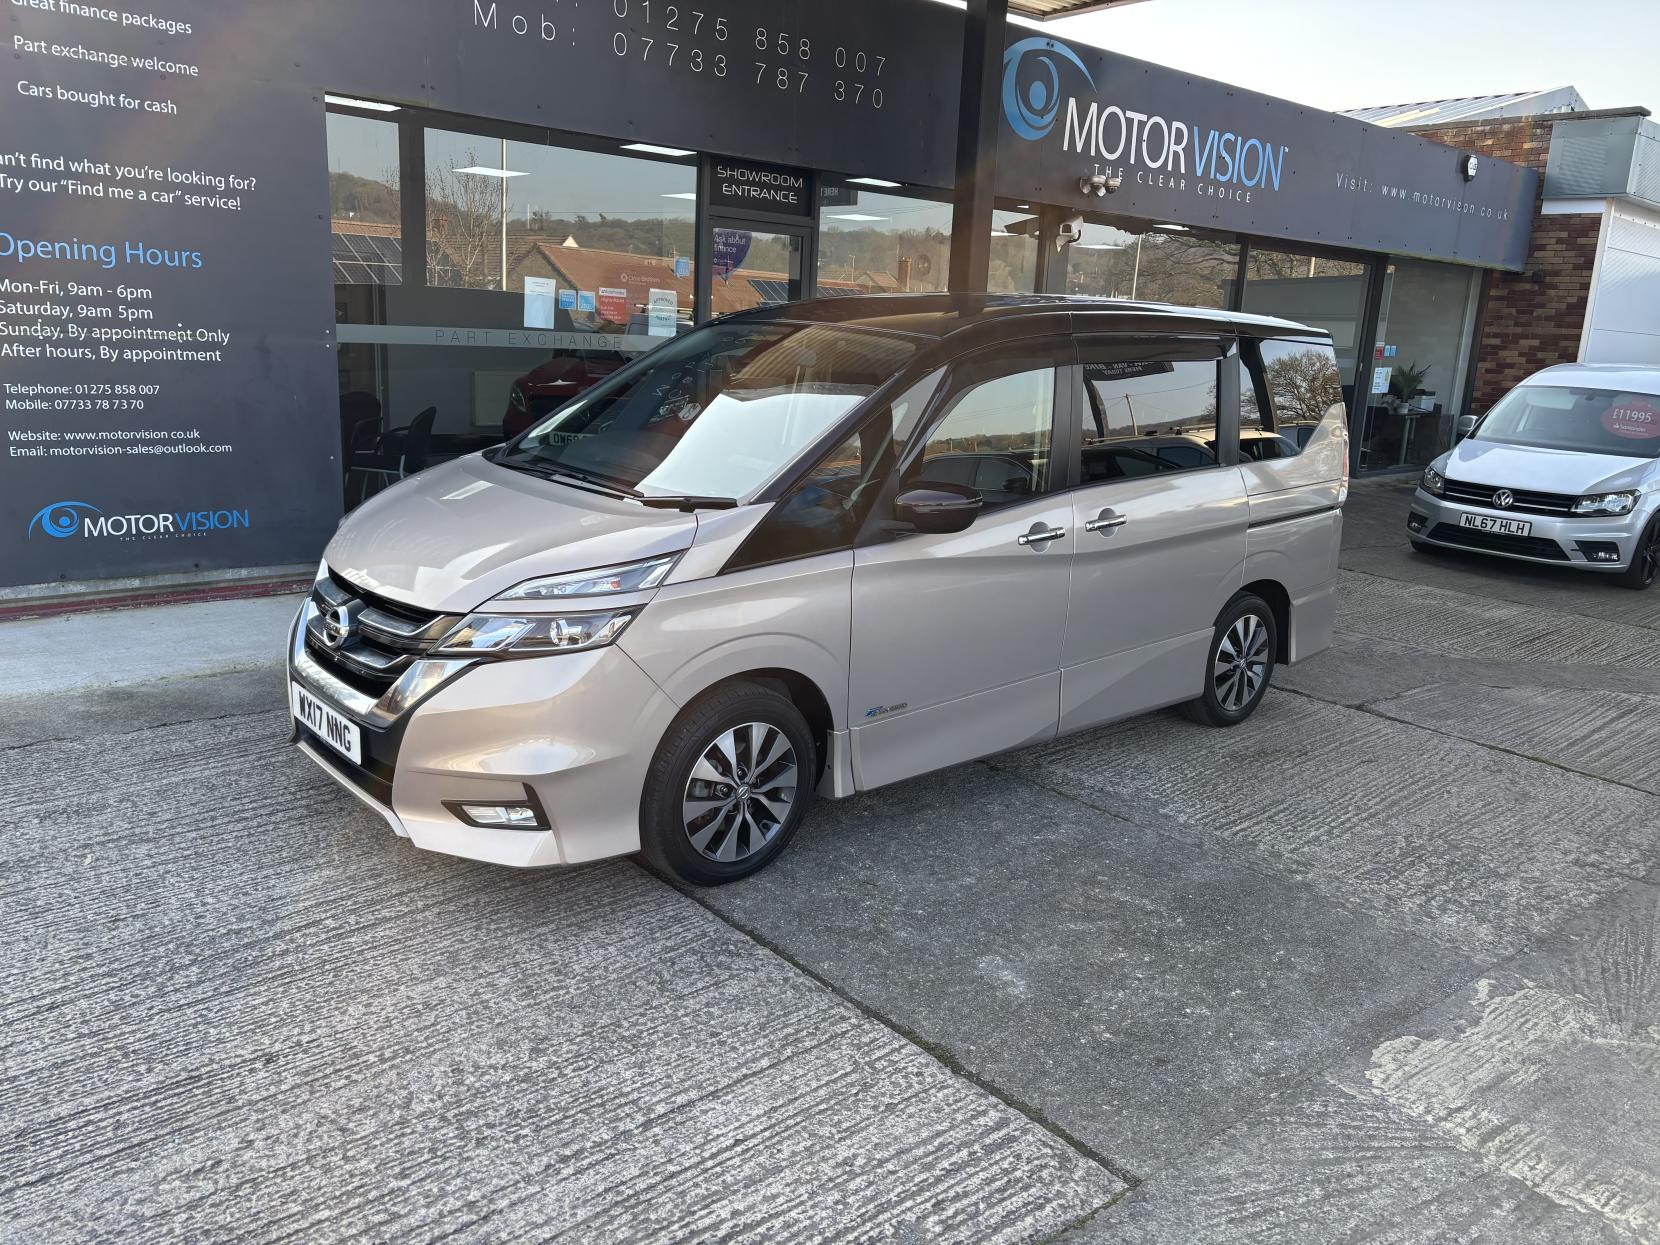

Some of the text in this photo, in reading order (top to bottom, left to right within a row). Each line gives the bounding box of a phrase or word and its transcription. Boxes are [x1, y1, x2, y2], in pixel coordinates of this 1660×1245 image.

[59, 0, 118, 21] finance
[122, 12, 192, 35] packages
[613, 0, 886, 77] 01275 858 007
[14, 35, 199, 77] Part exchange welcome
[474, 0, 883, 109] Mob: 07733 787 370
[17, 81, 177, 115] Cars bought for cash
[30, 153, 65, 171] find
[68, 158, 111, 176] what
[115, 164, 163, 183] you're
[167, 167, 226, 191] looking
[229, 174, 257, 191] for?
[717, 165, 803, 189] SHOWROOM
[1094, 164, 1251, 203] THE CLEAR CHOICE
[1337, 172, 1373, 192] Visit:
[0, 173, 24, 193] Try
[29, 179, 58, 192] our
[109, 186, 134, 200] me
[138, 188, 147, 201] a
[151, 189, 182, 204] car"
[184, 194, 242, 211] service!
[722, 183, 798, 204] ENTRANCE
[0, 232, 203, 269] Opening Hours
[0, 279, 64, 297] Mon-Fri,
[67, 282, 103, 297] 9am
[117, 284, 153, 301] 6pm
[0, 299, 153, 322] Saturday, 9am 5pm
[0, 321, 230, 346] Sunday, By appointment Only
[435, 329, 622, 349] PART EXCHANGE
[1, 342, 222, 363] After hours, By appointment
[3, 383, 160, 396] Telephone: 01275 858 007
[5, 399, 52, 410] Mobile:
[54, 399, 92, 410] 07733
[1612, 408, 1653, 423] £11995
[8, 430, 61, 441] Website:
[9, 443, 233, 457] Email: motorvision-sales@outlook.com
[1463, 515, 1497, 530] NL67
[1499, 520, 1526, 535] HLH
[299, 690, 352, 753] WX17 NNG
